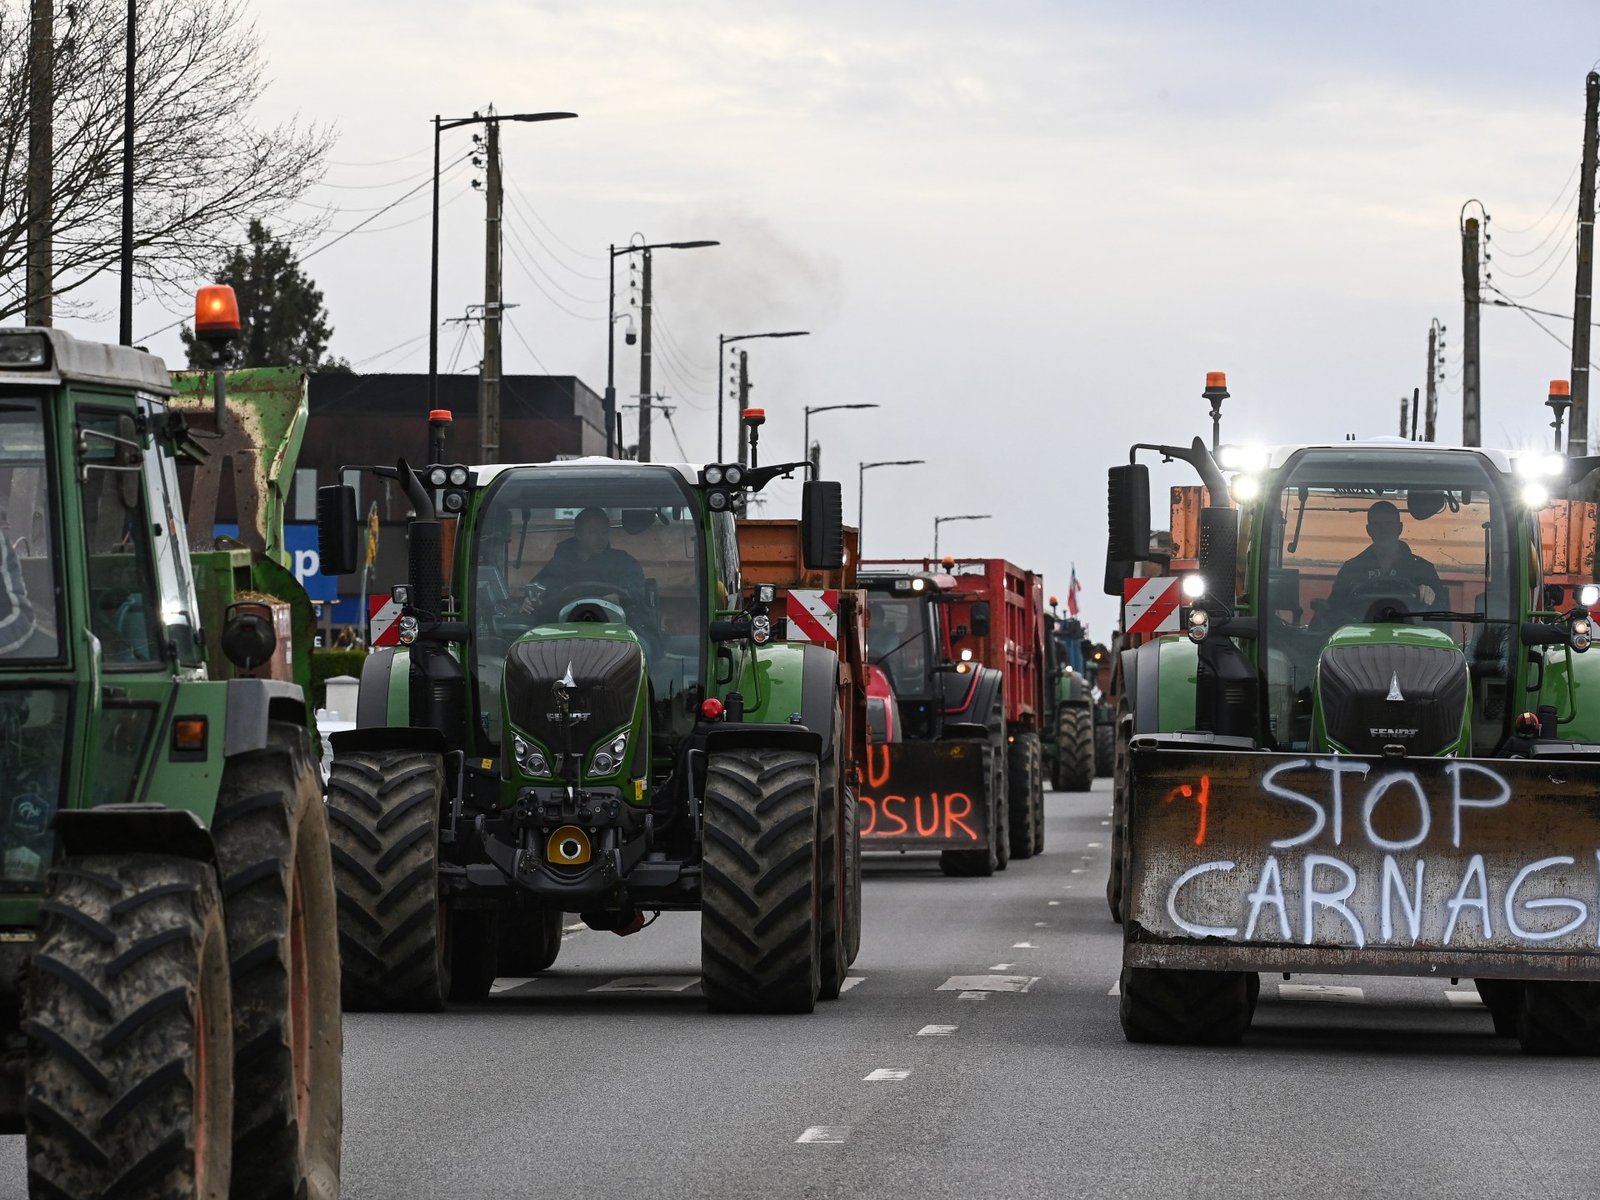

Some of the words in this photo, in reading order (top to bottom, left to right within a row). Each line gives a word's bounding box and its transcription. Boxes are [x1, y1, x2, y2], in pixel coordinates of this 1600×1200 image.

[857, 744, 890, 788] U
[1370, 728, 1419, 738] FENDT
[1262, 757, 1511, 850] STOP
[1167, 849, 1600, 948] CARNAG
